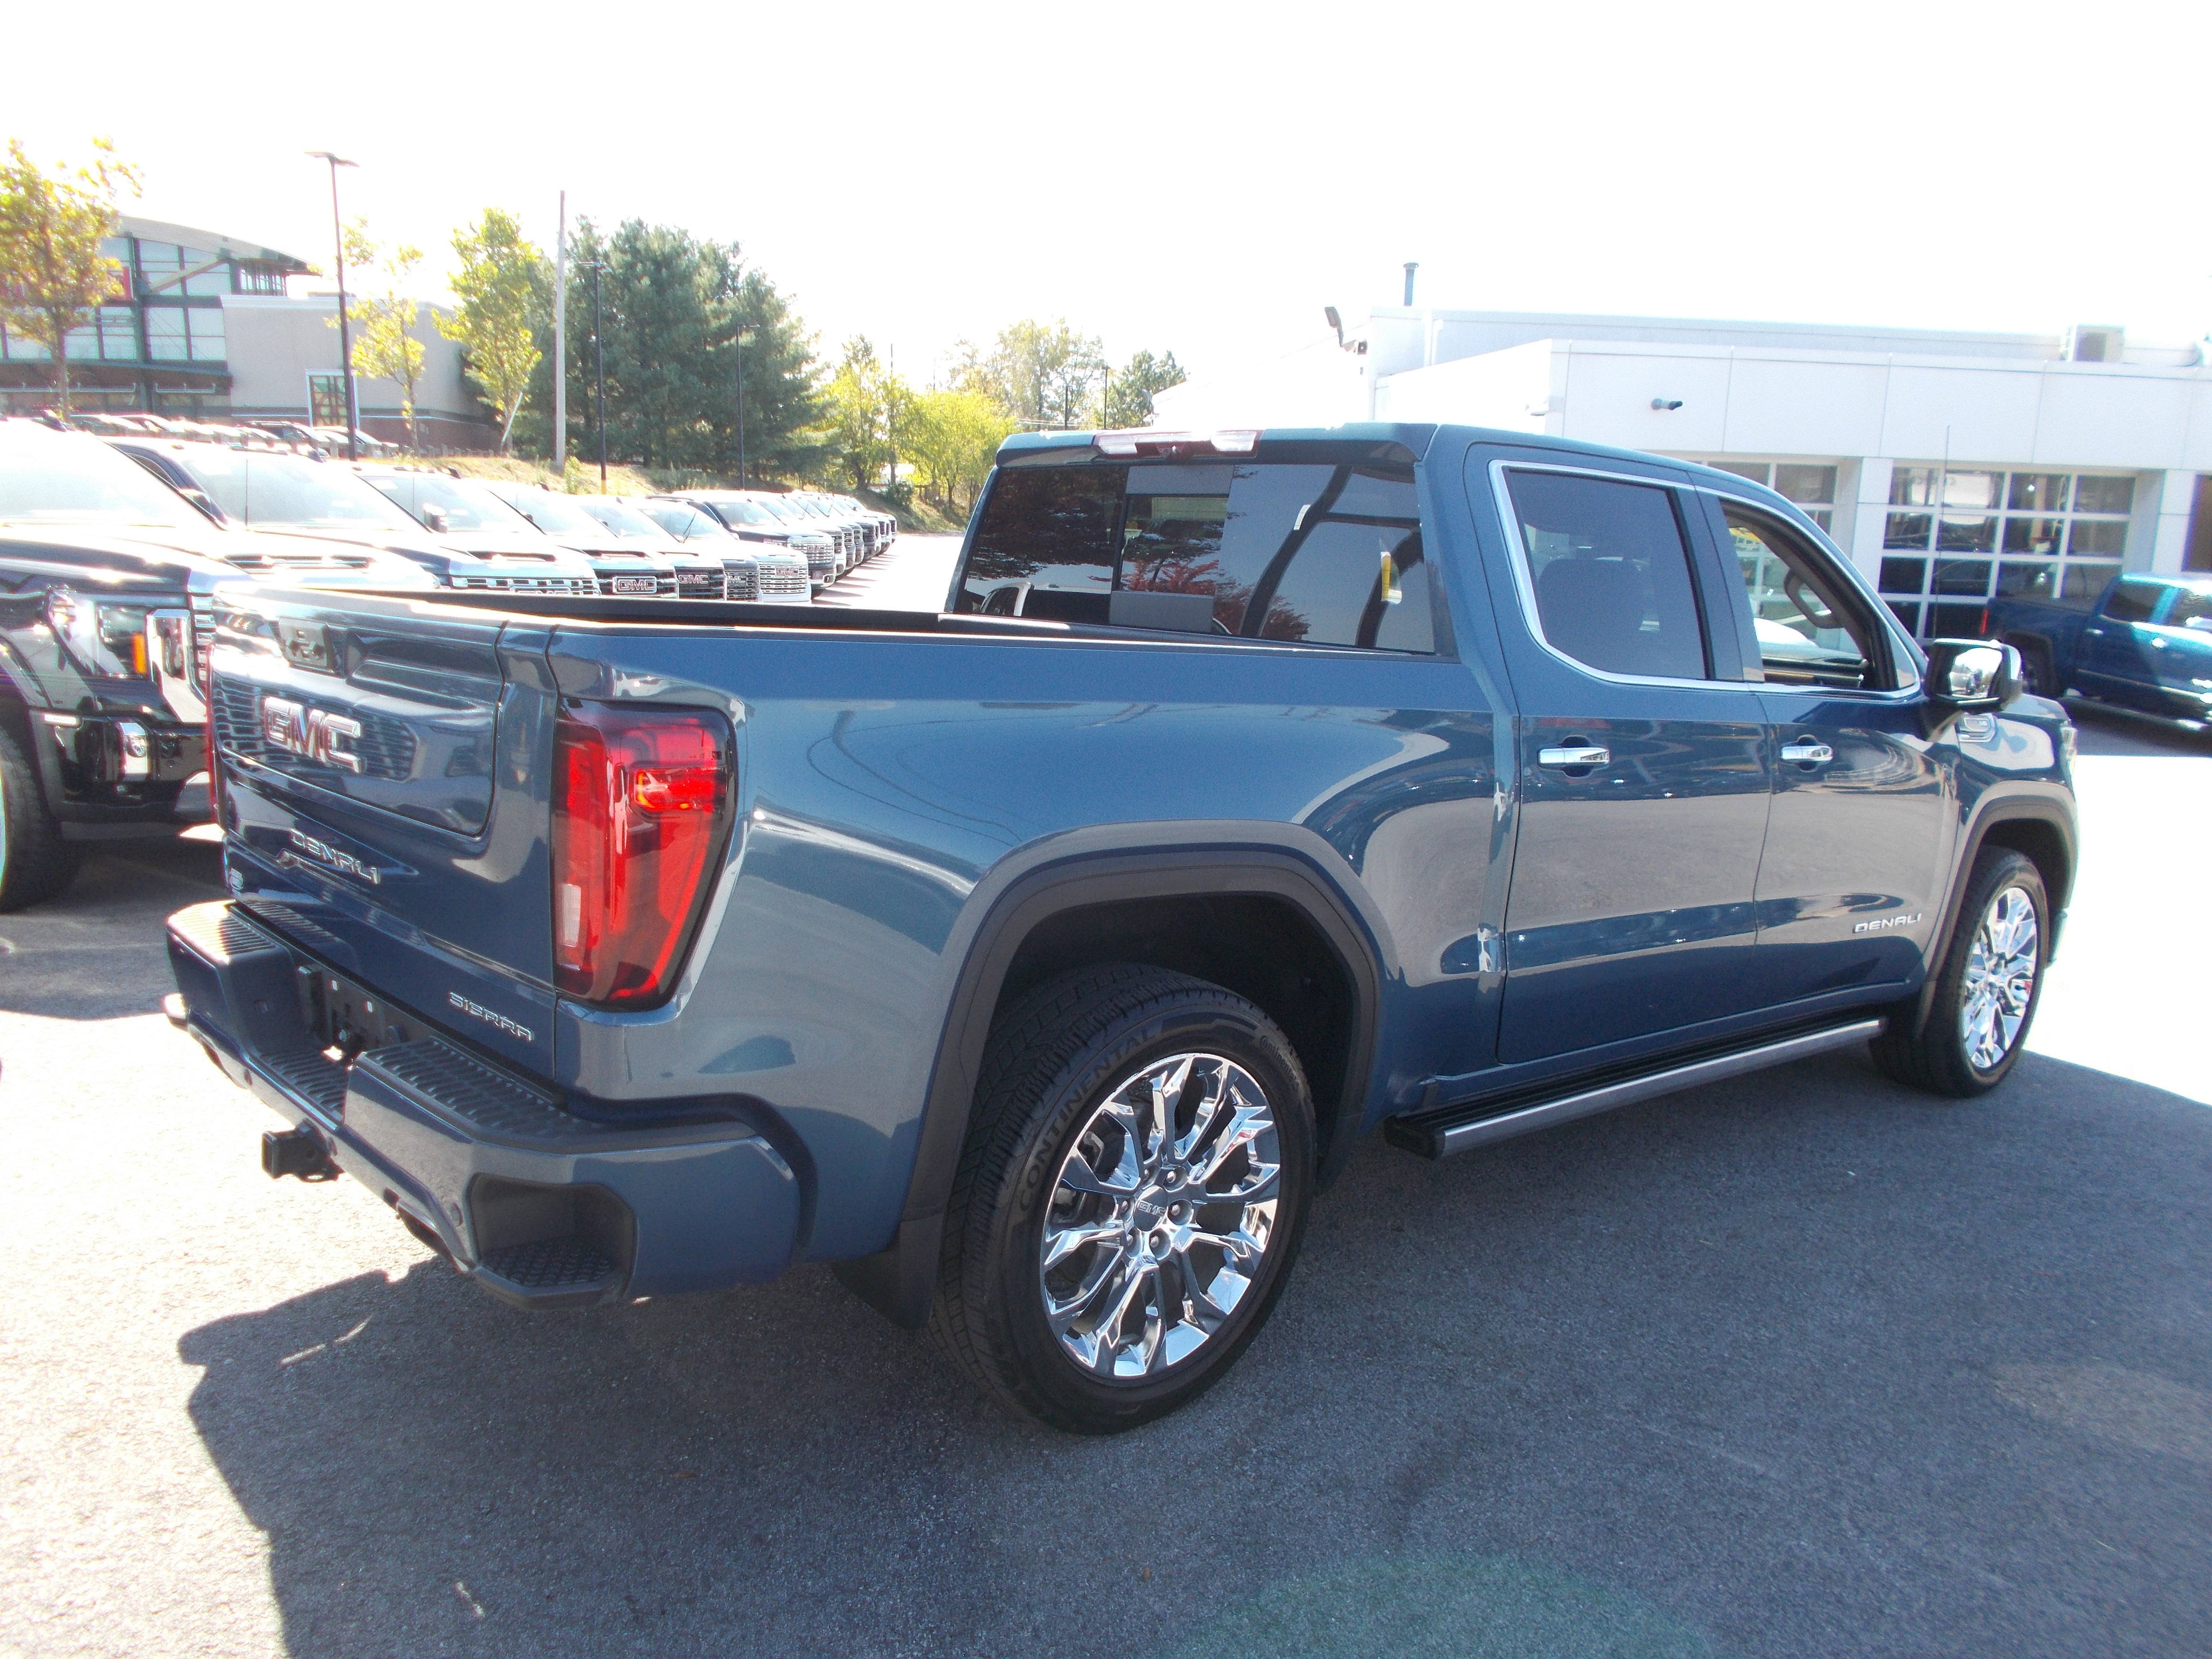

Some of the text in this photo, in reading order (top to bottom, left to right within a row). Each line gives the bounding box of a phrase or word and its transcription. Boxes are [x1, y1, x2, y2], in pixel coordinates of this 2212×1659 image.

[618, 578, 657, 591] GMC
[678, 574, 709, 584] GMC
[264, 697, 362, 773] GMC
[290, 829, 380, 885] DENALI
[1852, 913, 1922, 933] DENALI
[449, 992, 535, 1042] SIERRA
[1020, 1028, 1152, 1211] CONTINENTAL
[1136, 1200, 1166, 1216] GMC
